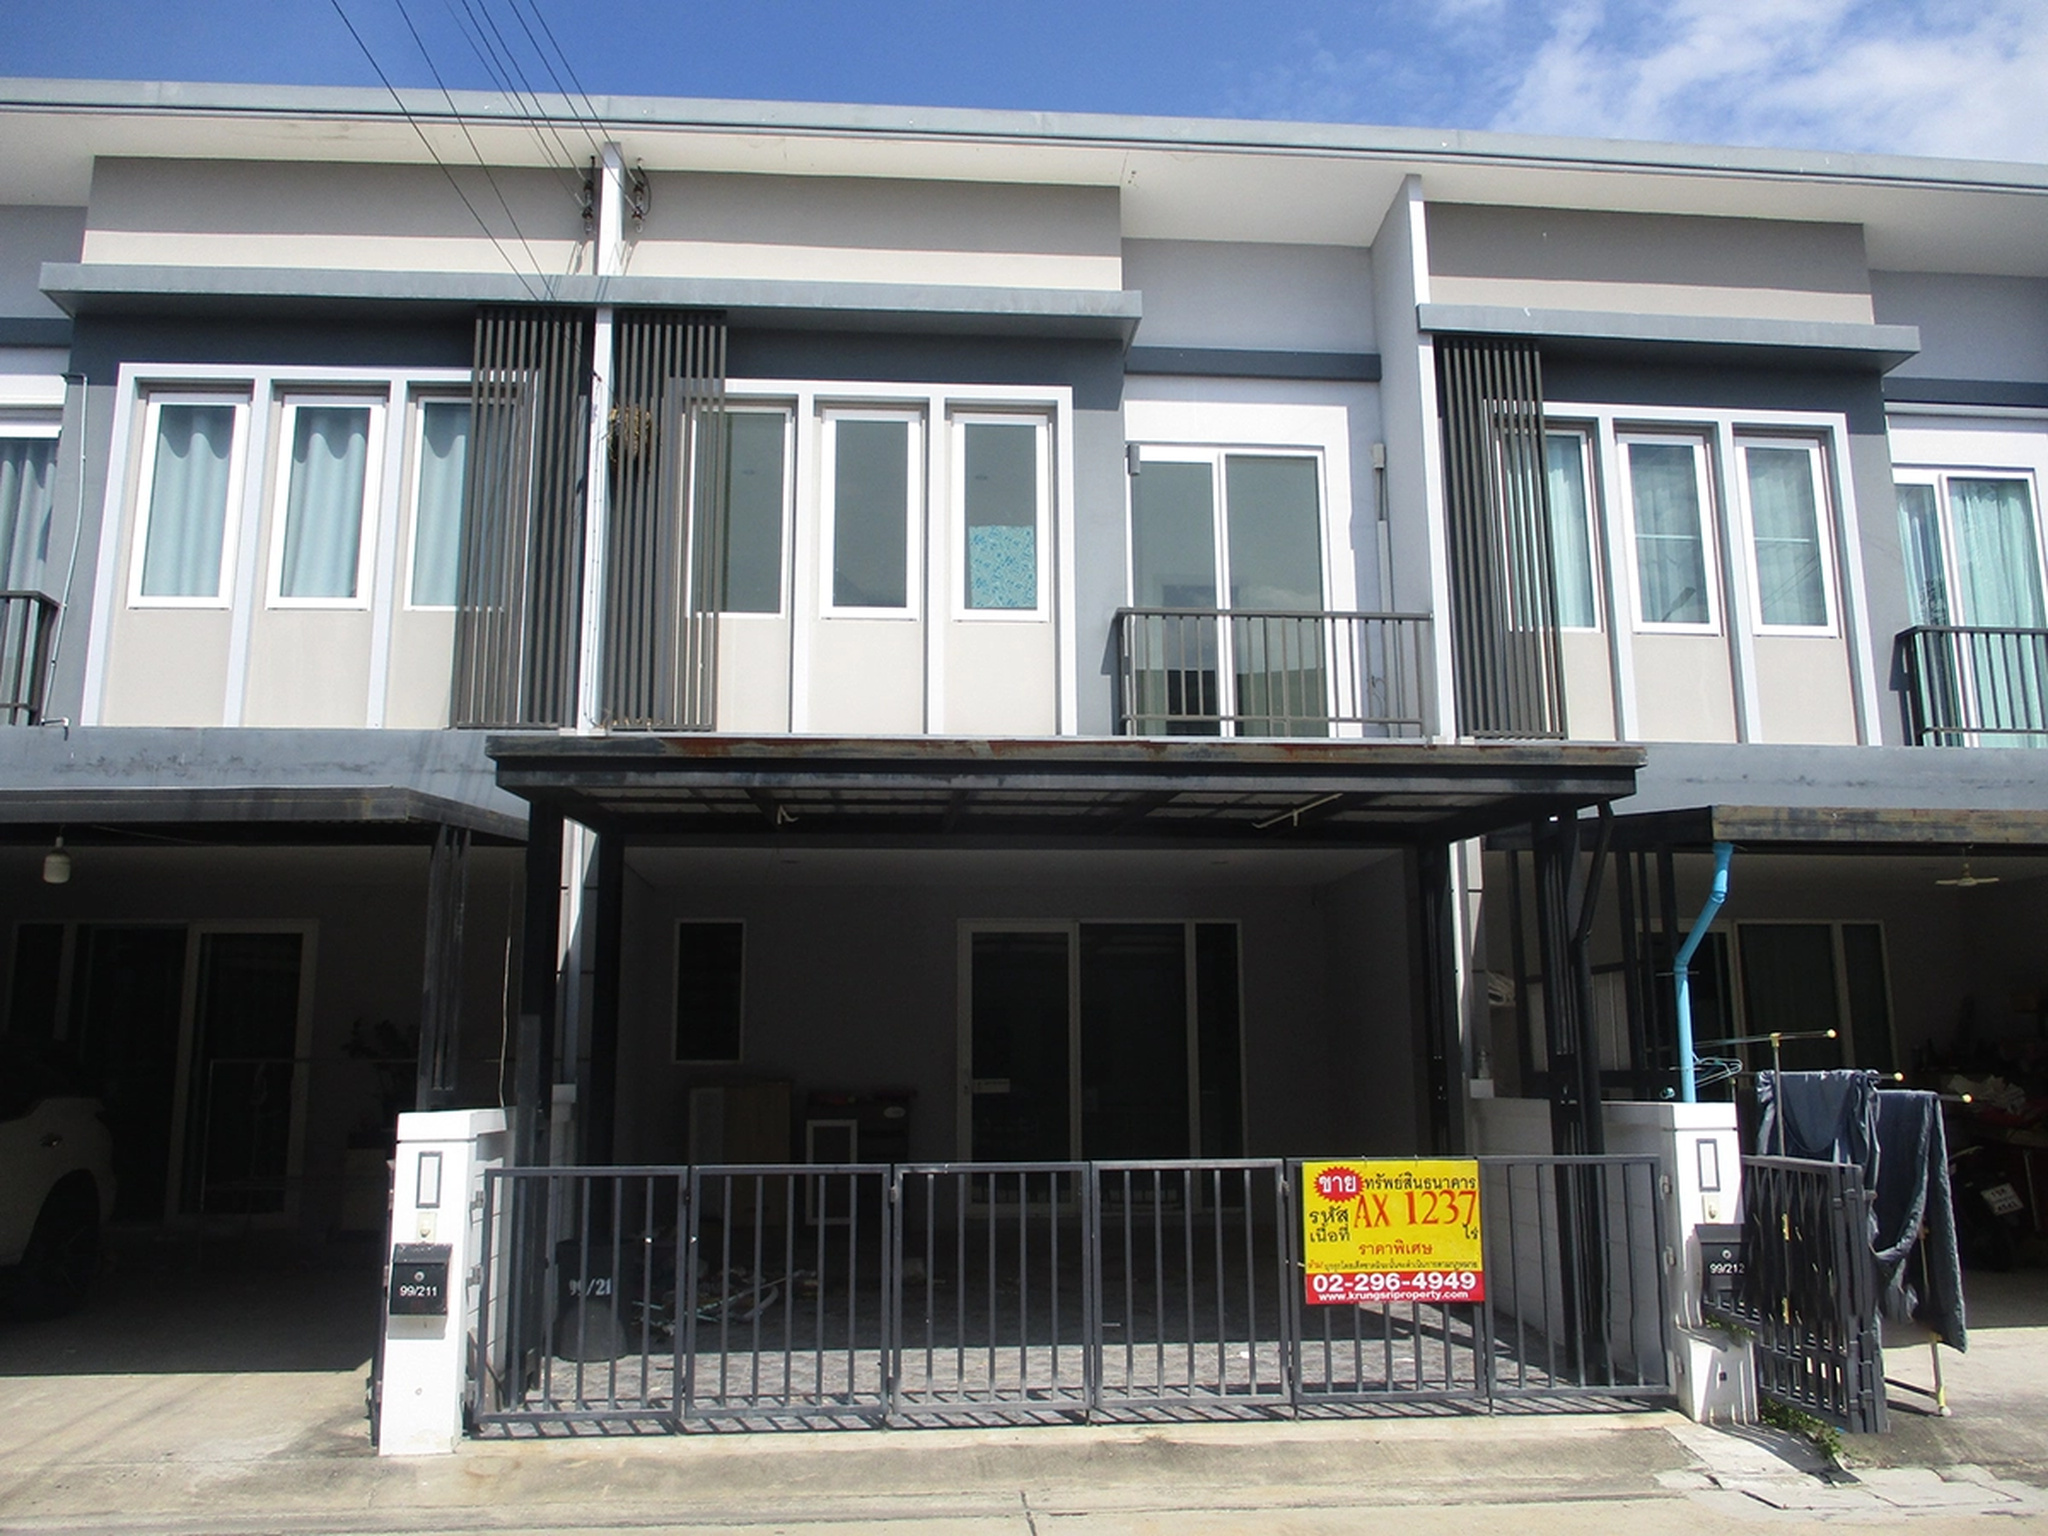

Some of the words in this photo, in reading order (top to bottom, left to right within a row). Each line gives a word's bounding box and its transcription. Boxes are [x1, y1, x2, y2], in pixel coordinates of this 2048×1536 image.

[1364, 1171, 1476, 1190] ทรัพย์สินธนาคาร
[1309, 1205, 1348, 1226] รหัส
[1354, 1194, 1390, 1228] AX
[1405, 1190, 1478, 1224] 1237
[1358, 1239, 1433, 1255] ราคาพิเศษ
[1709, 1263, 1745, 1274] 99/212
[400, 1284, 437, 1297] 99/211
[1312, 1272, 1476, 1292] 02-296-4949
[1318, 1289, 1469, 1301] www.krungsriproperty.com
